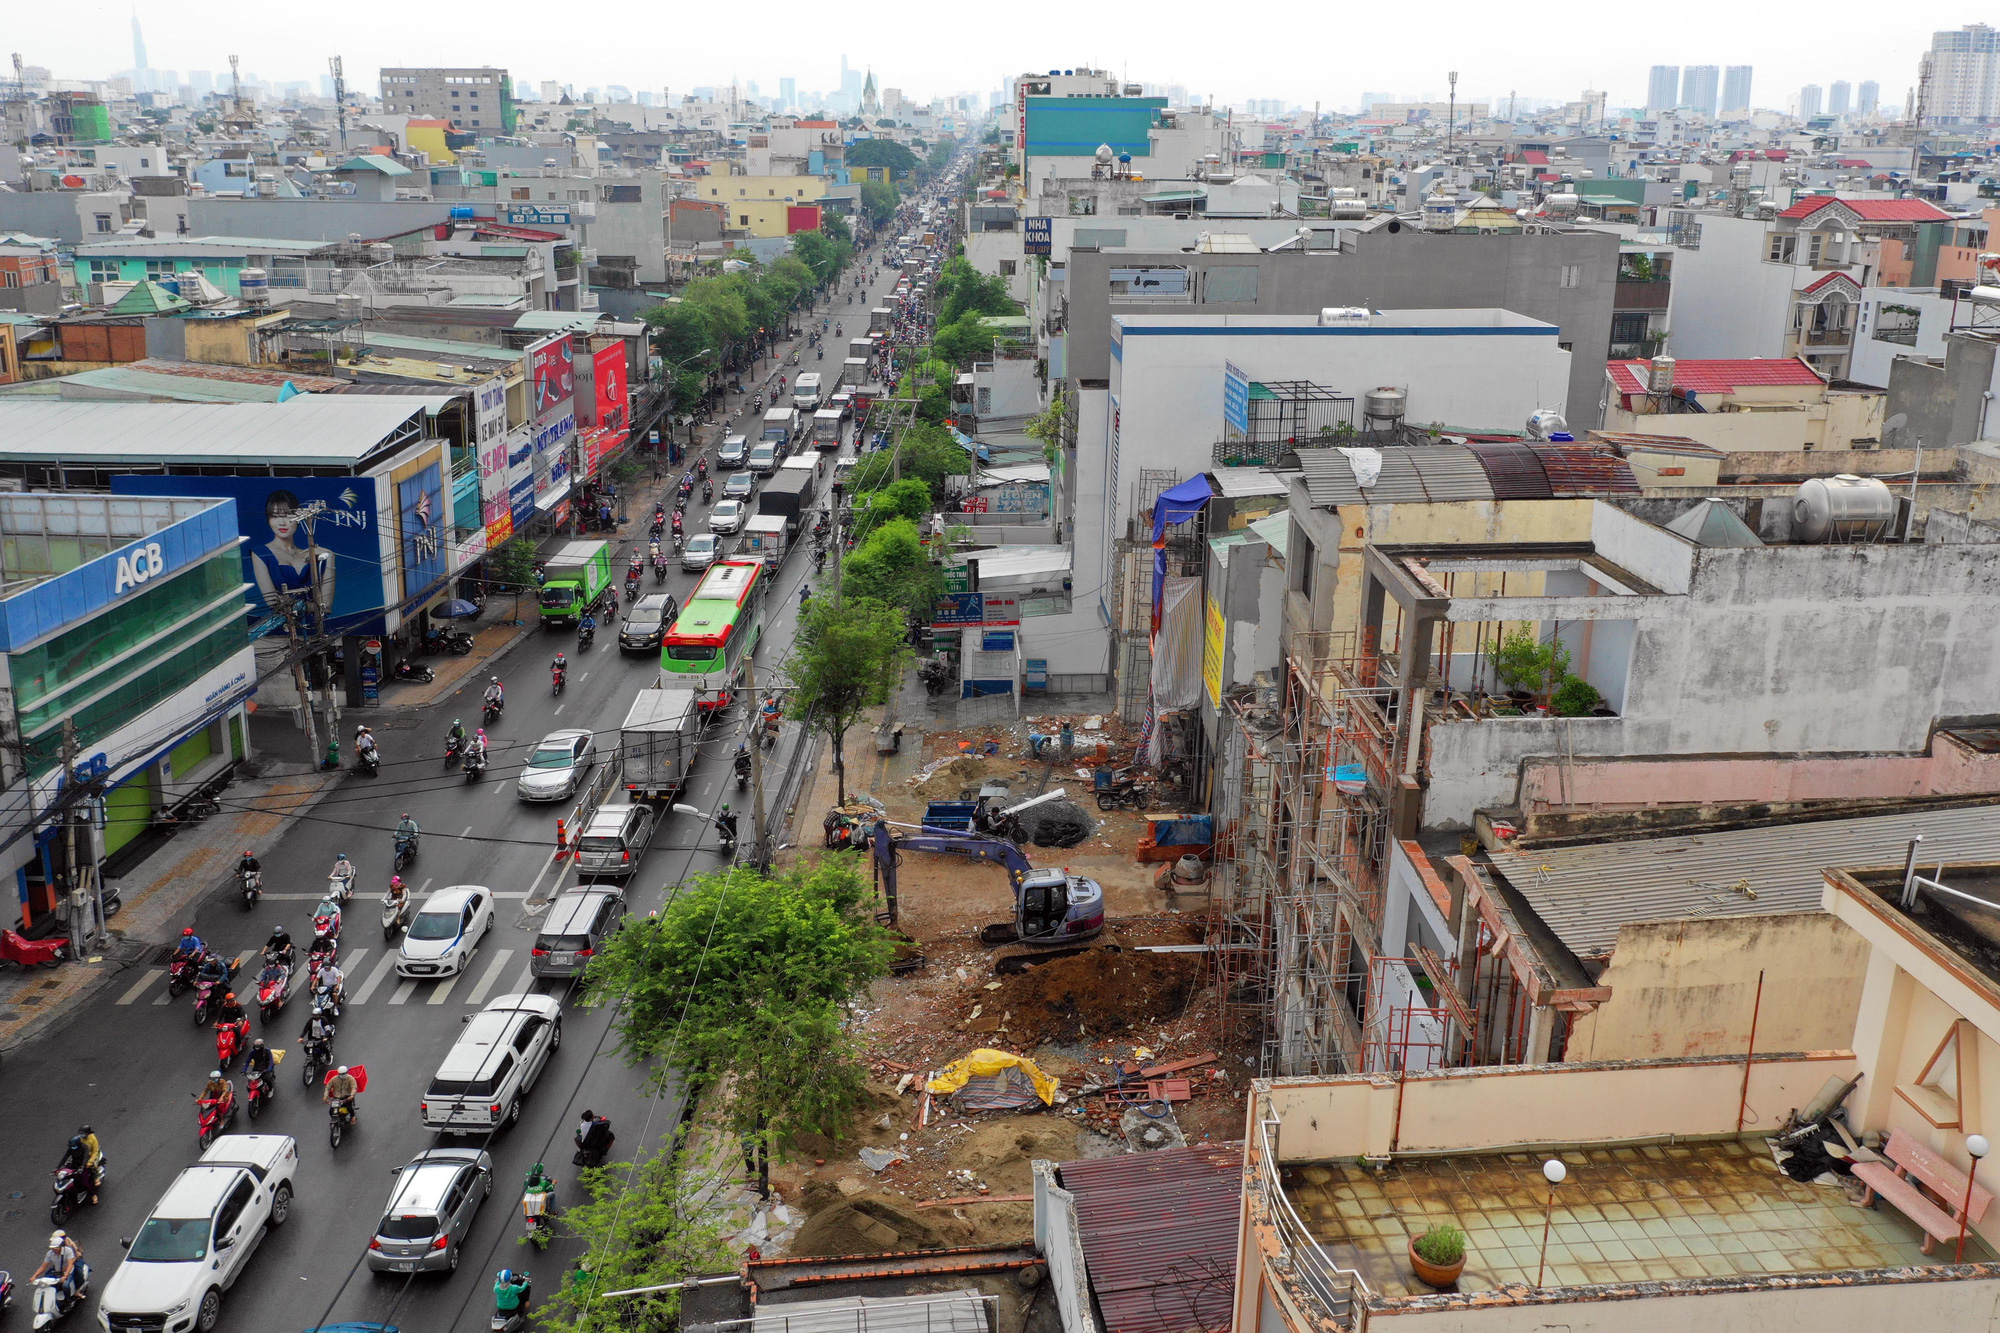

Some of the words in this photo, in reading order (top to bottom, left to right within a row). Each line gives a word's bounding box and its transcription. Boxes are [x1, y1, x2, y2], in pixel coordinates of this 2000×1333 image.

[1028, 219, 1047, 230] NHA
[1025, 231, 1050, 243] KHOA
[335, 510, 367, 530] PNJ
[414, 526, 438, 565] PNJ
[115, 543, 163, 594] ACB
